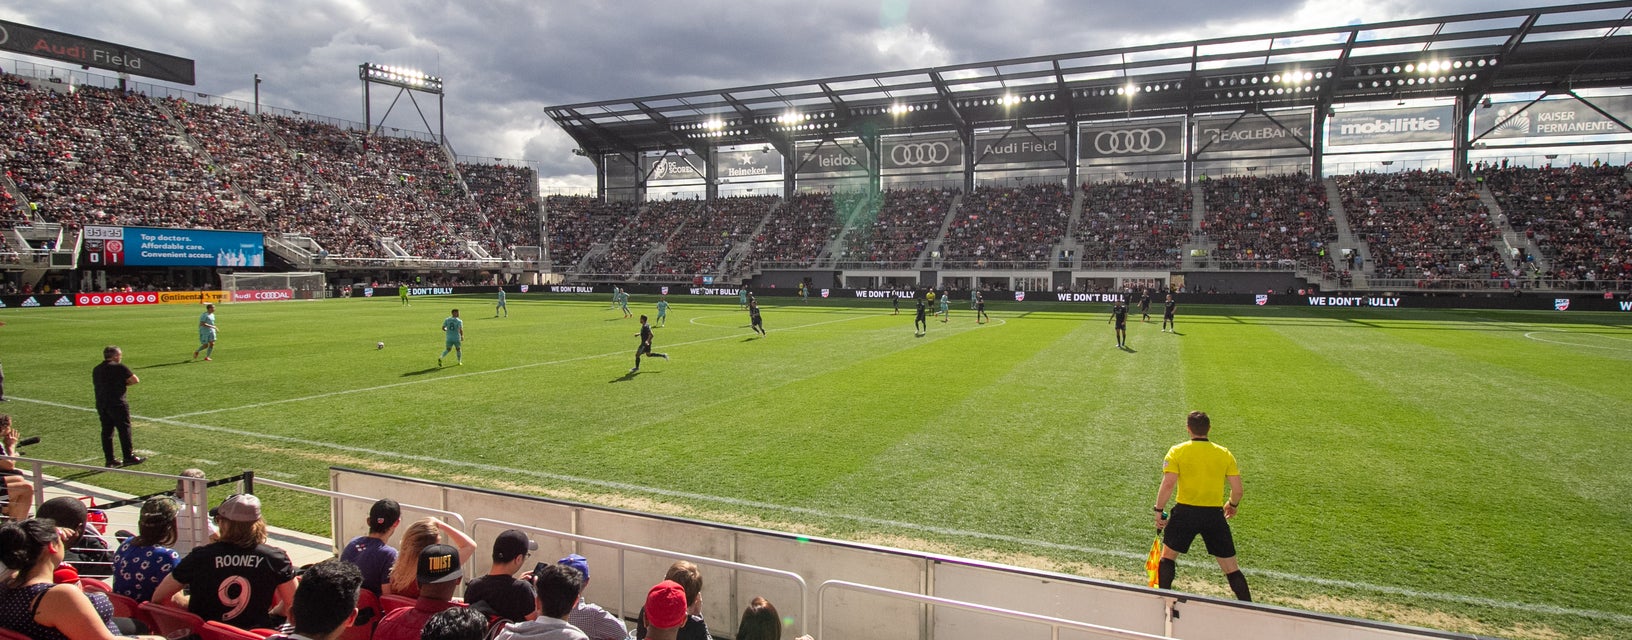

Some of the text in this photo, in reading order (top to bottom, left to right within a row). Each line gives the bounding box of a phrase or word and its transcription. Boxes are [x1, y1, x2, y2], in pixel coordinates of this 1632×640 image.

[33, 39, 142, 69] Audi Field
[1537, 111, 1575, 122] KAISER
[1341, 117, 1440, 134] mobilitie
[1537, 121, 1613, 133] PERMANENTE
[983, 140, 1056, 154] Audi Field
[819, 153, 857, 167] leidos
[669, 165, 694, 174] SCORES
[728, 165, 767, 176] Heineken
[140, 233, 192, 243] Top doctors.
[141, 242, 205, 252] Affordable care.
[90, 252, 118, 263] 0 1
[141, 251, 215, 260] Convenient access.
[413, 287, 432, 295] DON'T
[433, 287, 453, 295] BULLY
[690, 287, 700, 295] WE
[856, 290, 867, 298] WE
[868, 290, 891, 298] DON'T
[160, 293, 203, 303] Continental
[1058, 293, 1125, 302] WE DON'T BULL
[1308, 296, 1400, 307] WE DON'T ULLY
[215, 554, 264, 569] ROONEY
[429, 554, 452, 571] TWIST
[218, 575, 252, 621] 9
